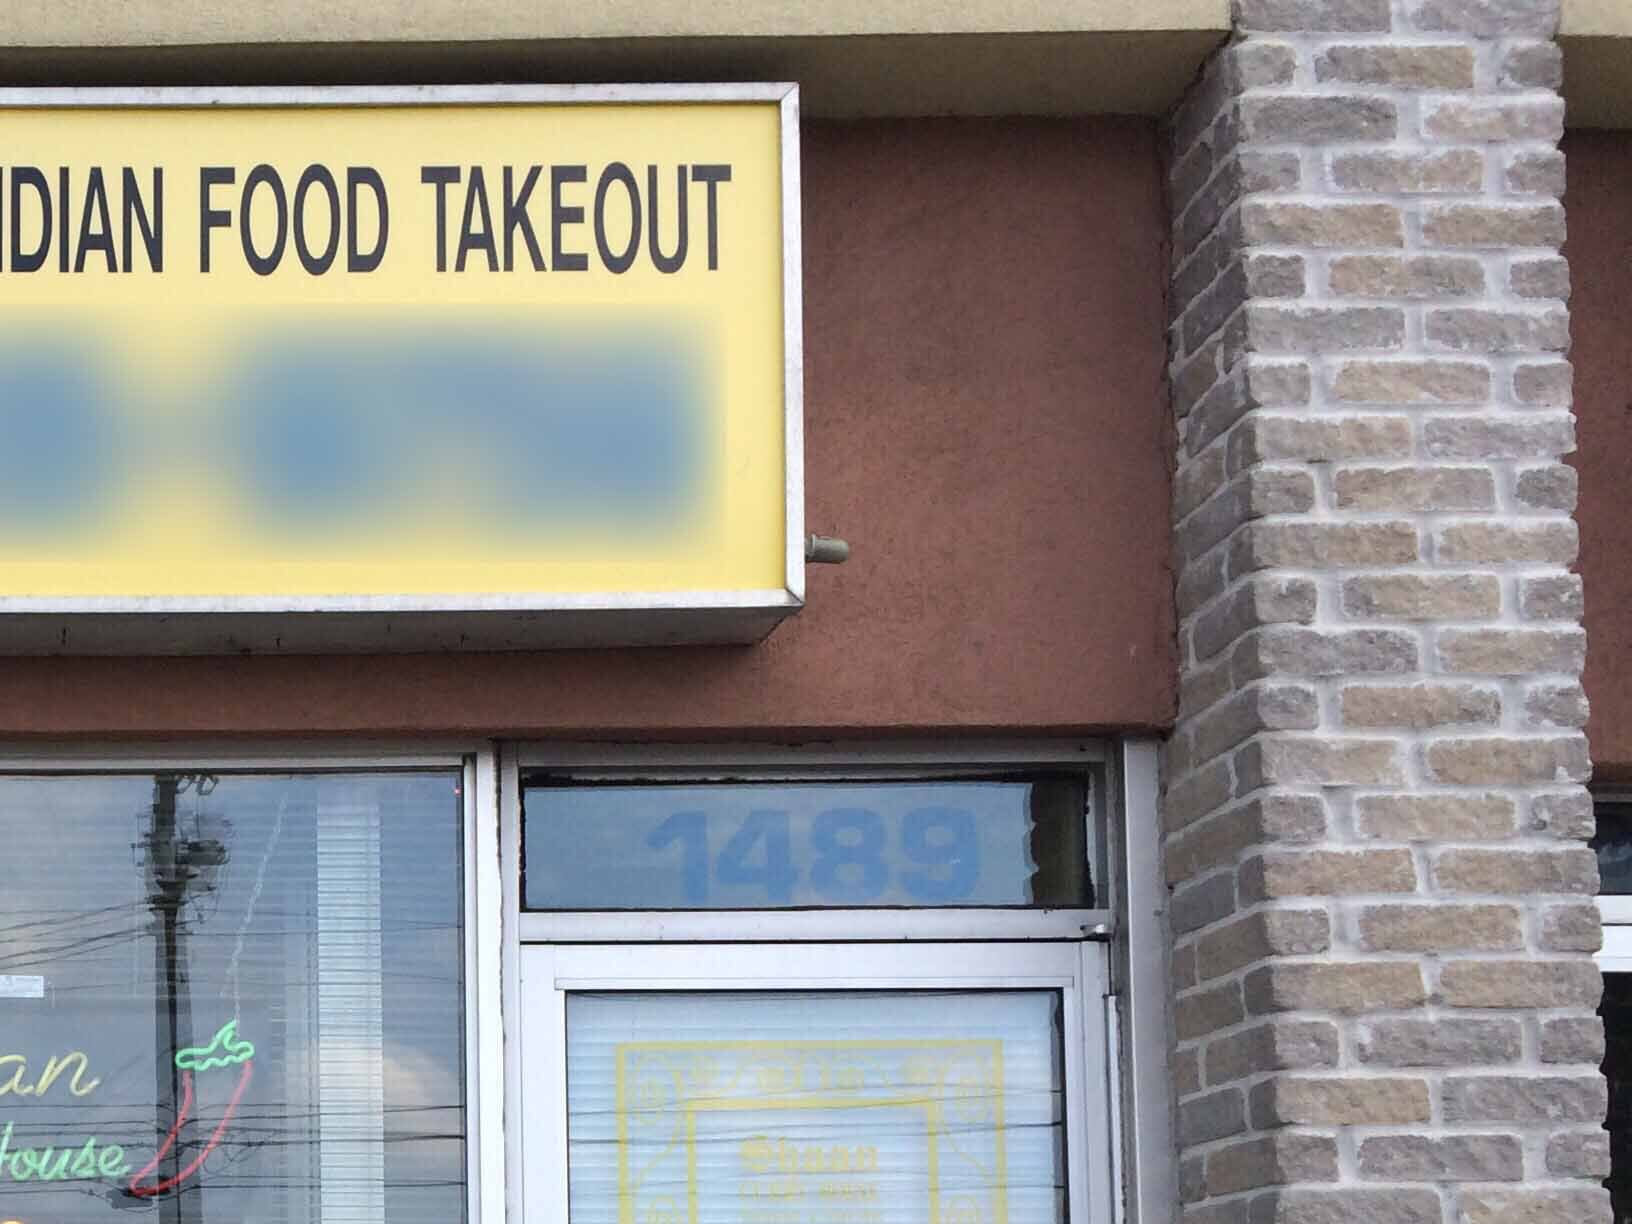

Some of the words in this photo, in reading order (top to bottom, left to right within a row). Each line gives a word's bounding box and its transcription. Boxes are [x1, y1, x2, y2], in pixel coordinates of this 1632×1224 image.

[200, 163, 389, 275] FOOD
[421, 161, 732, 274] TAKEOUT
[645, 806, 982, 901] 1489
